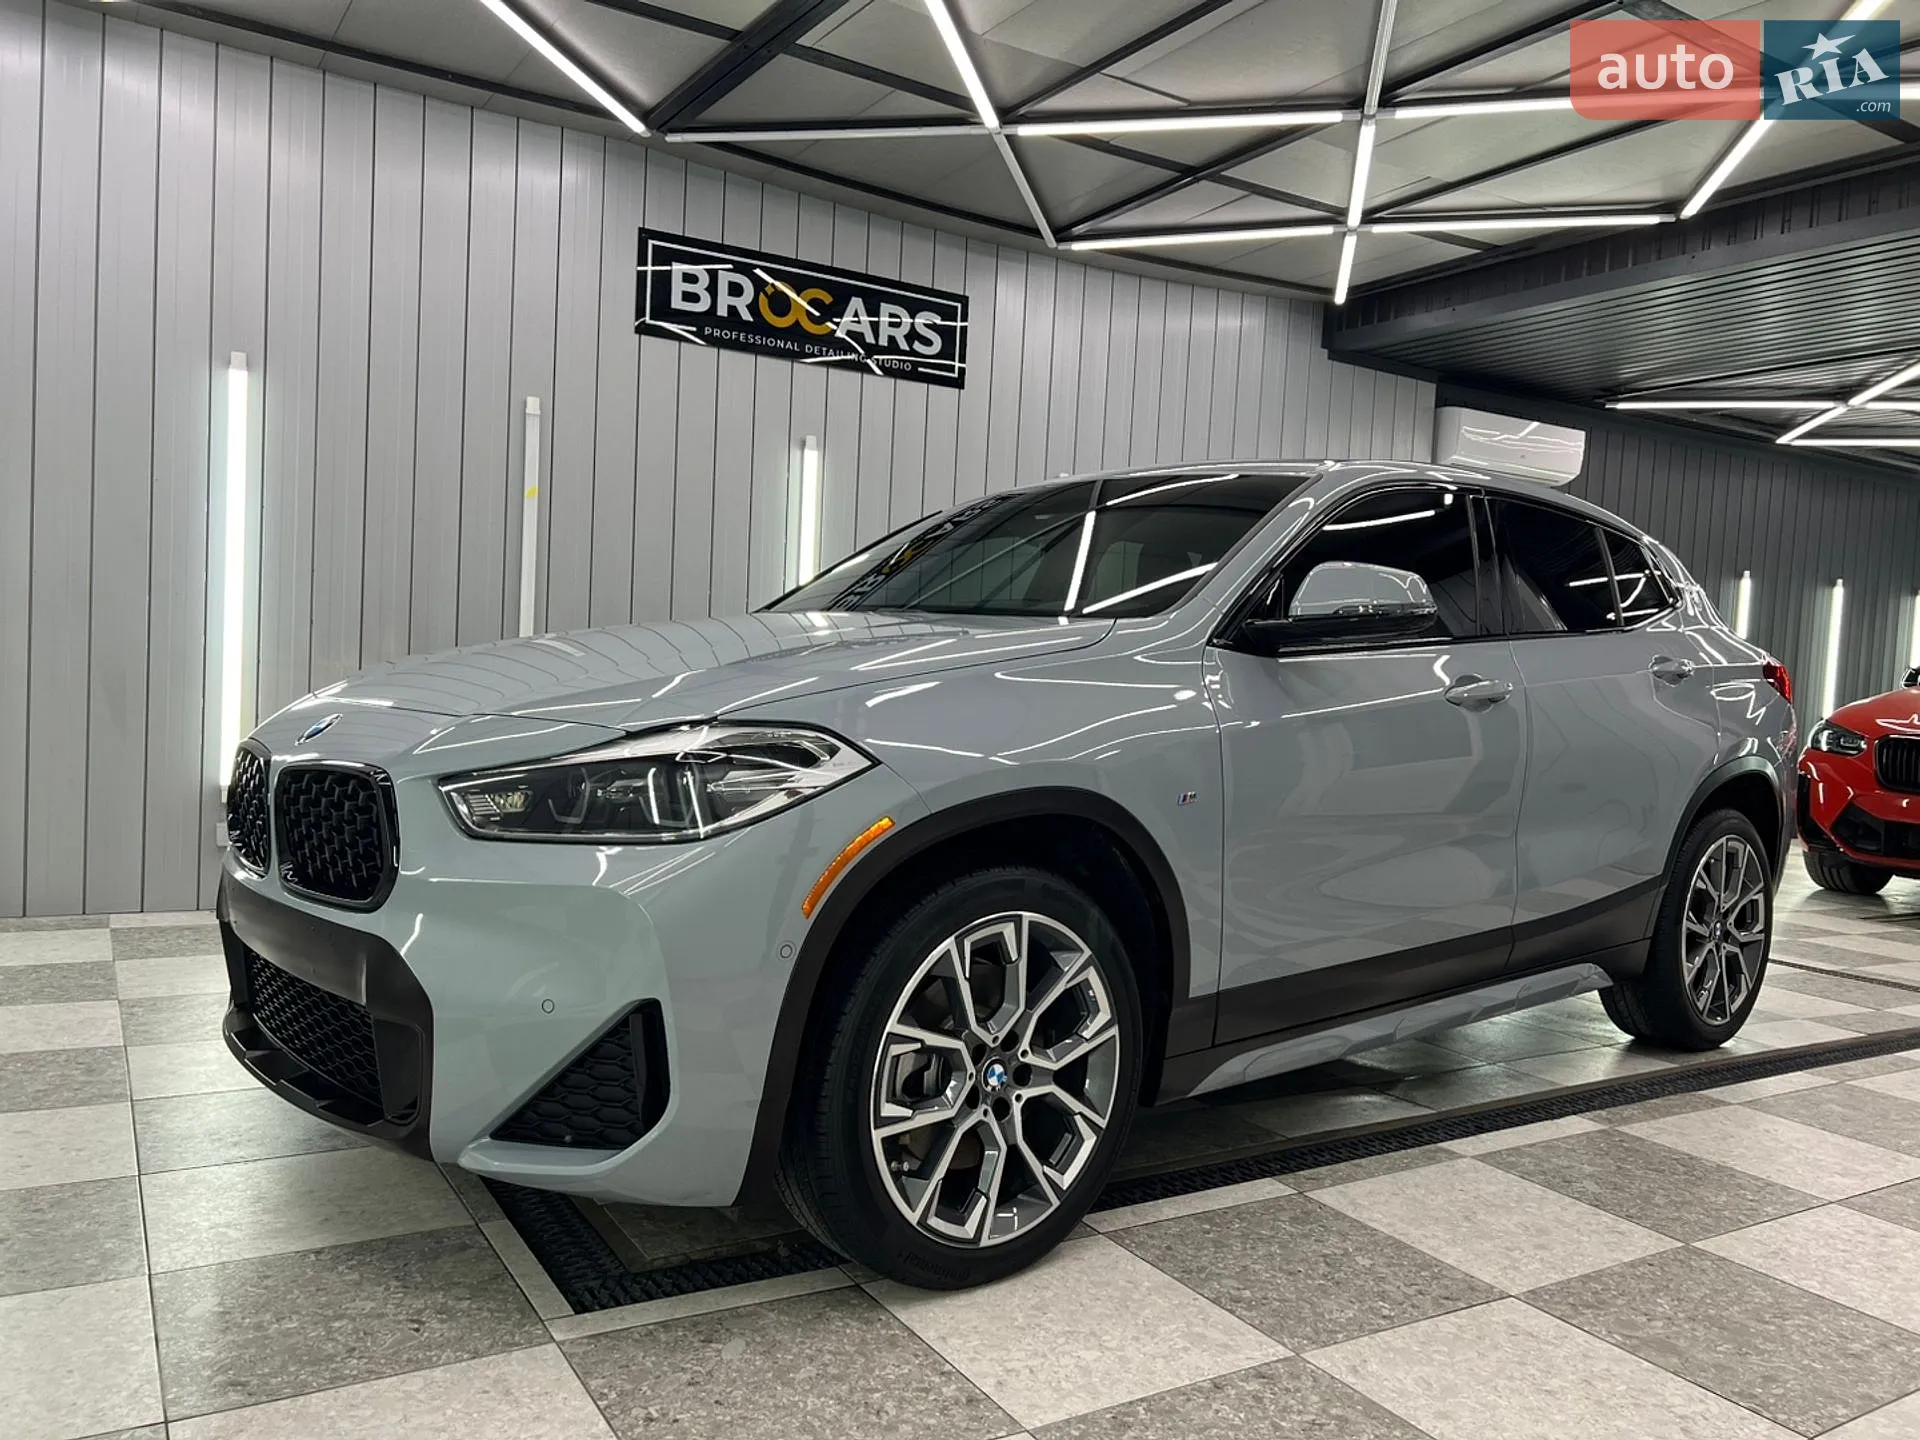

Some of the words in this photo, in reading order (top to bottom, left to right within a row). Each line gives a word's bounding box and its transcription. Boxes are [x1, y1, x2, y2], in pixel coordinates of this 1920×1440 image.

[670, 262, 942, 355] BROCARS
[704, 326, 799, 351] PROFESSIONAL
[805, 344, 867, 363] DETAILING
[871, 356, 912, 371] STUDIO
